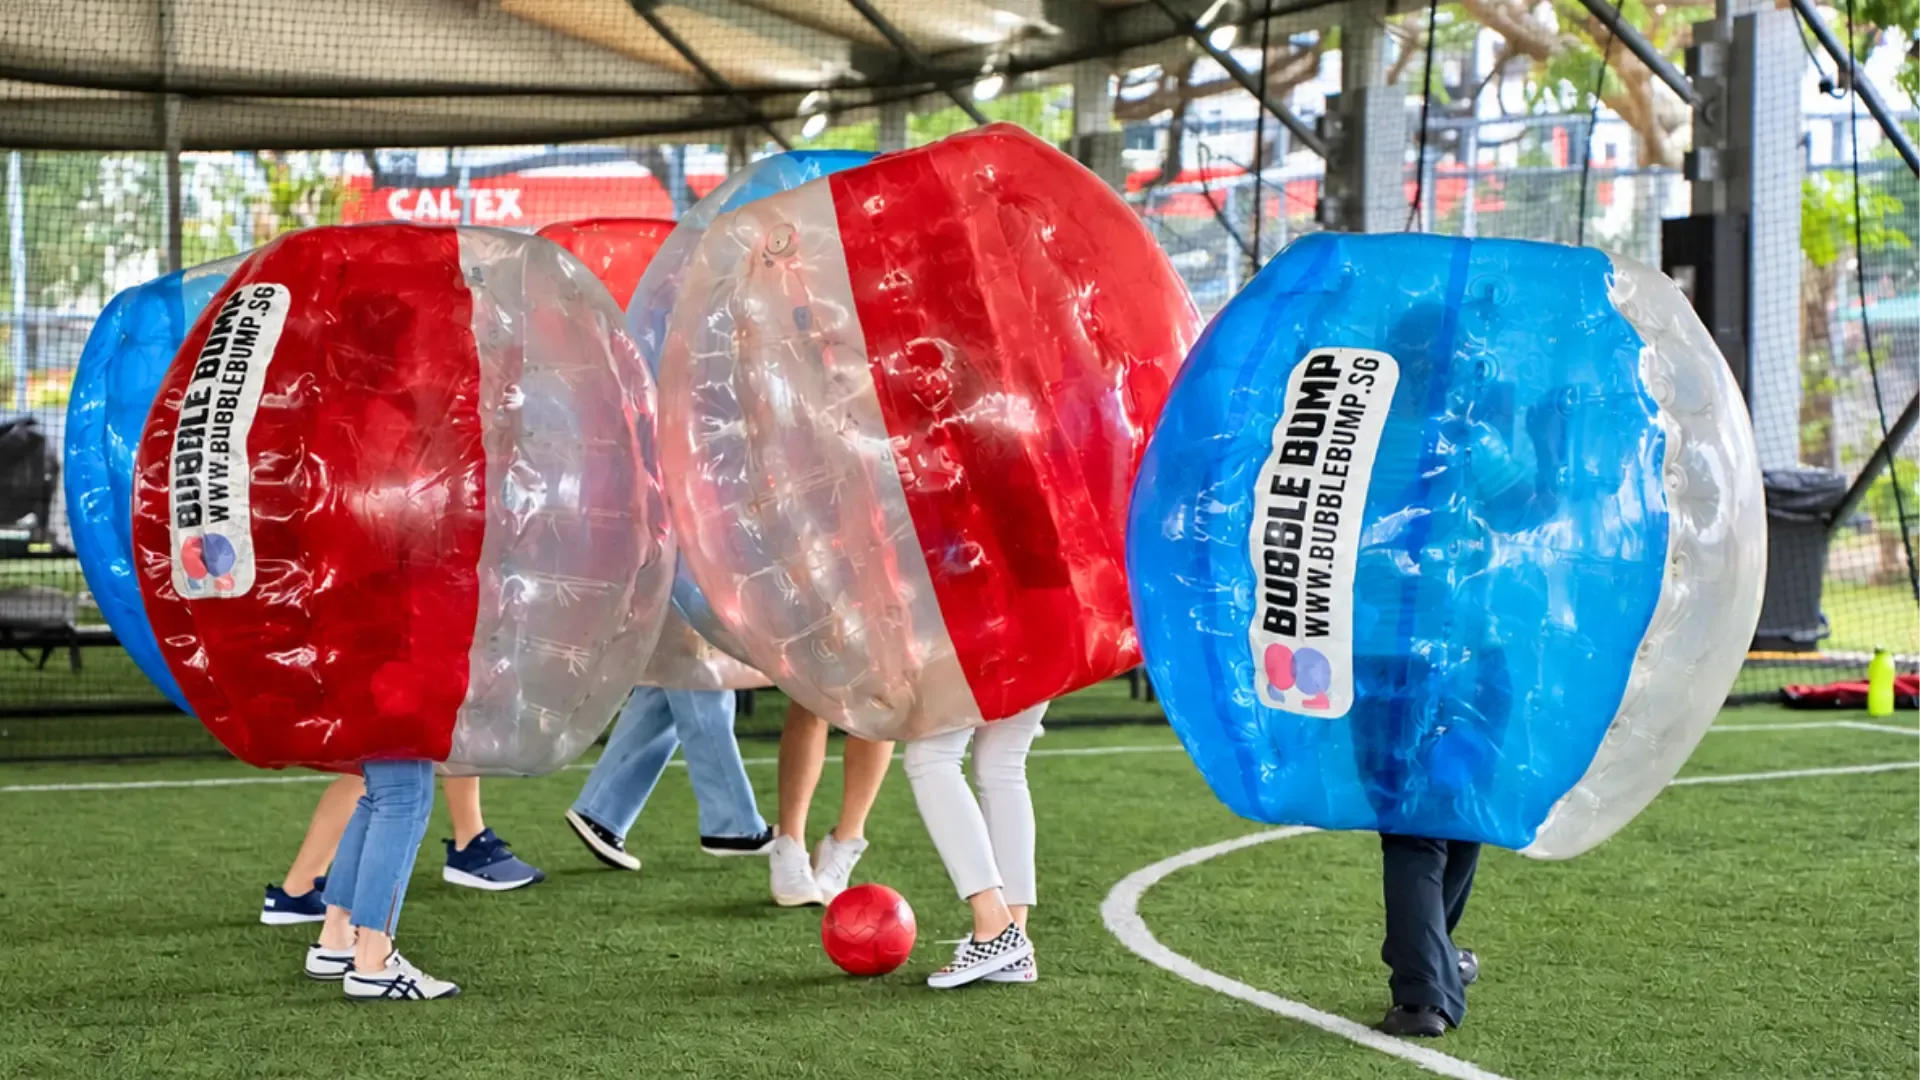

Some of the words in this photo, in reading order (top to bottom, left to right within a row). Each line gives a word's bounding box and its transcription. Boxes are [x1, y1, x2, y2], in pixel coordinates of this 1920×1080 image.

[175, 386, 212, 528] BUBBLE
[207, 286, 276, 524] WWW.BUBBLEBUMP.SG
[1279, 354, 1342, 466] BUMP
[1263, 475, 1312, 638] BUBBLE
[1304, 356, 1380, 638] WWW.BUBBLEBUMP.SG
